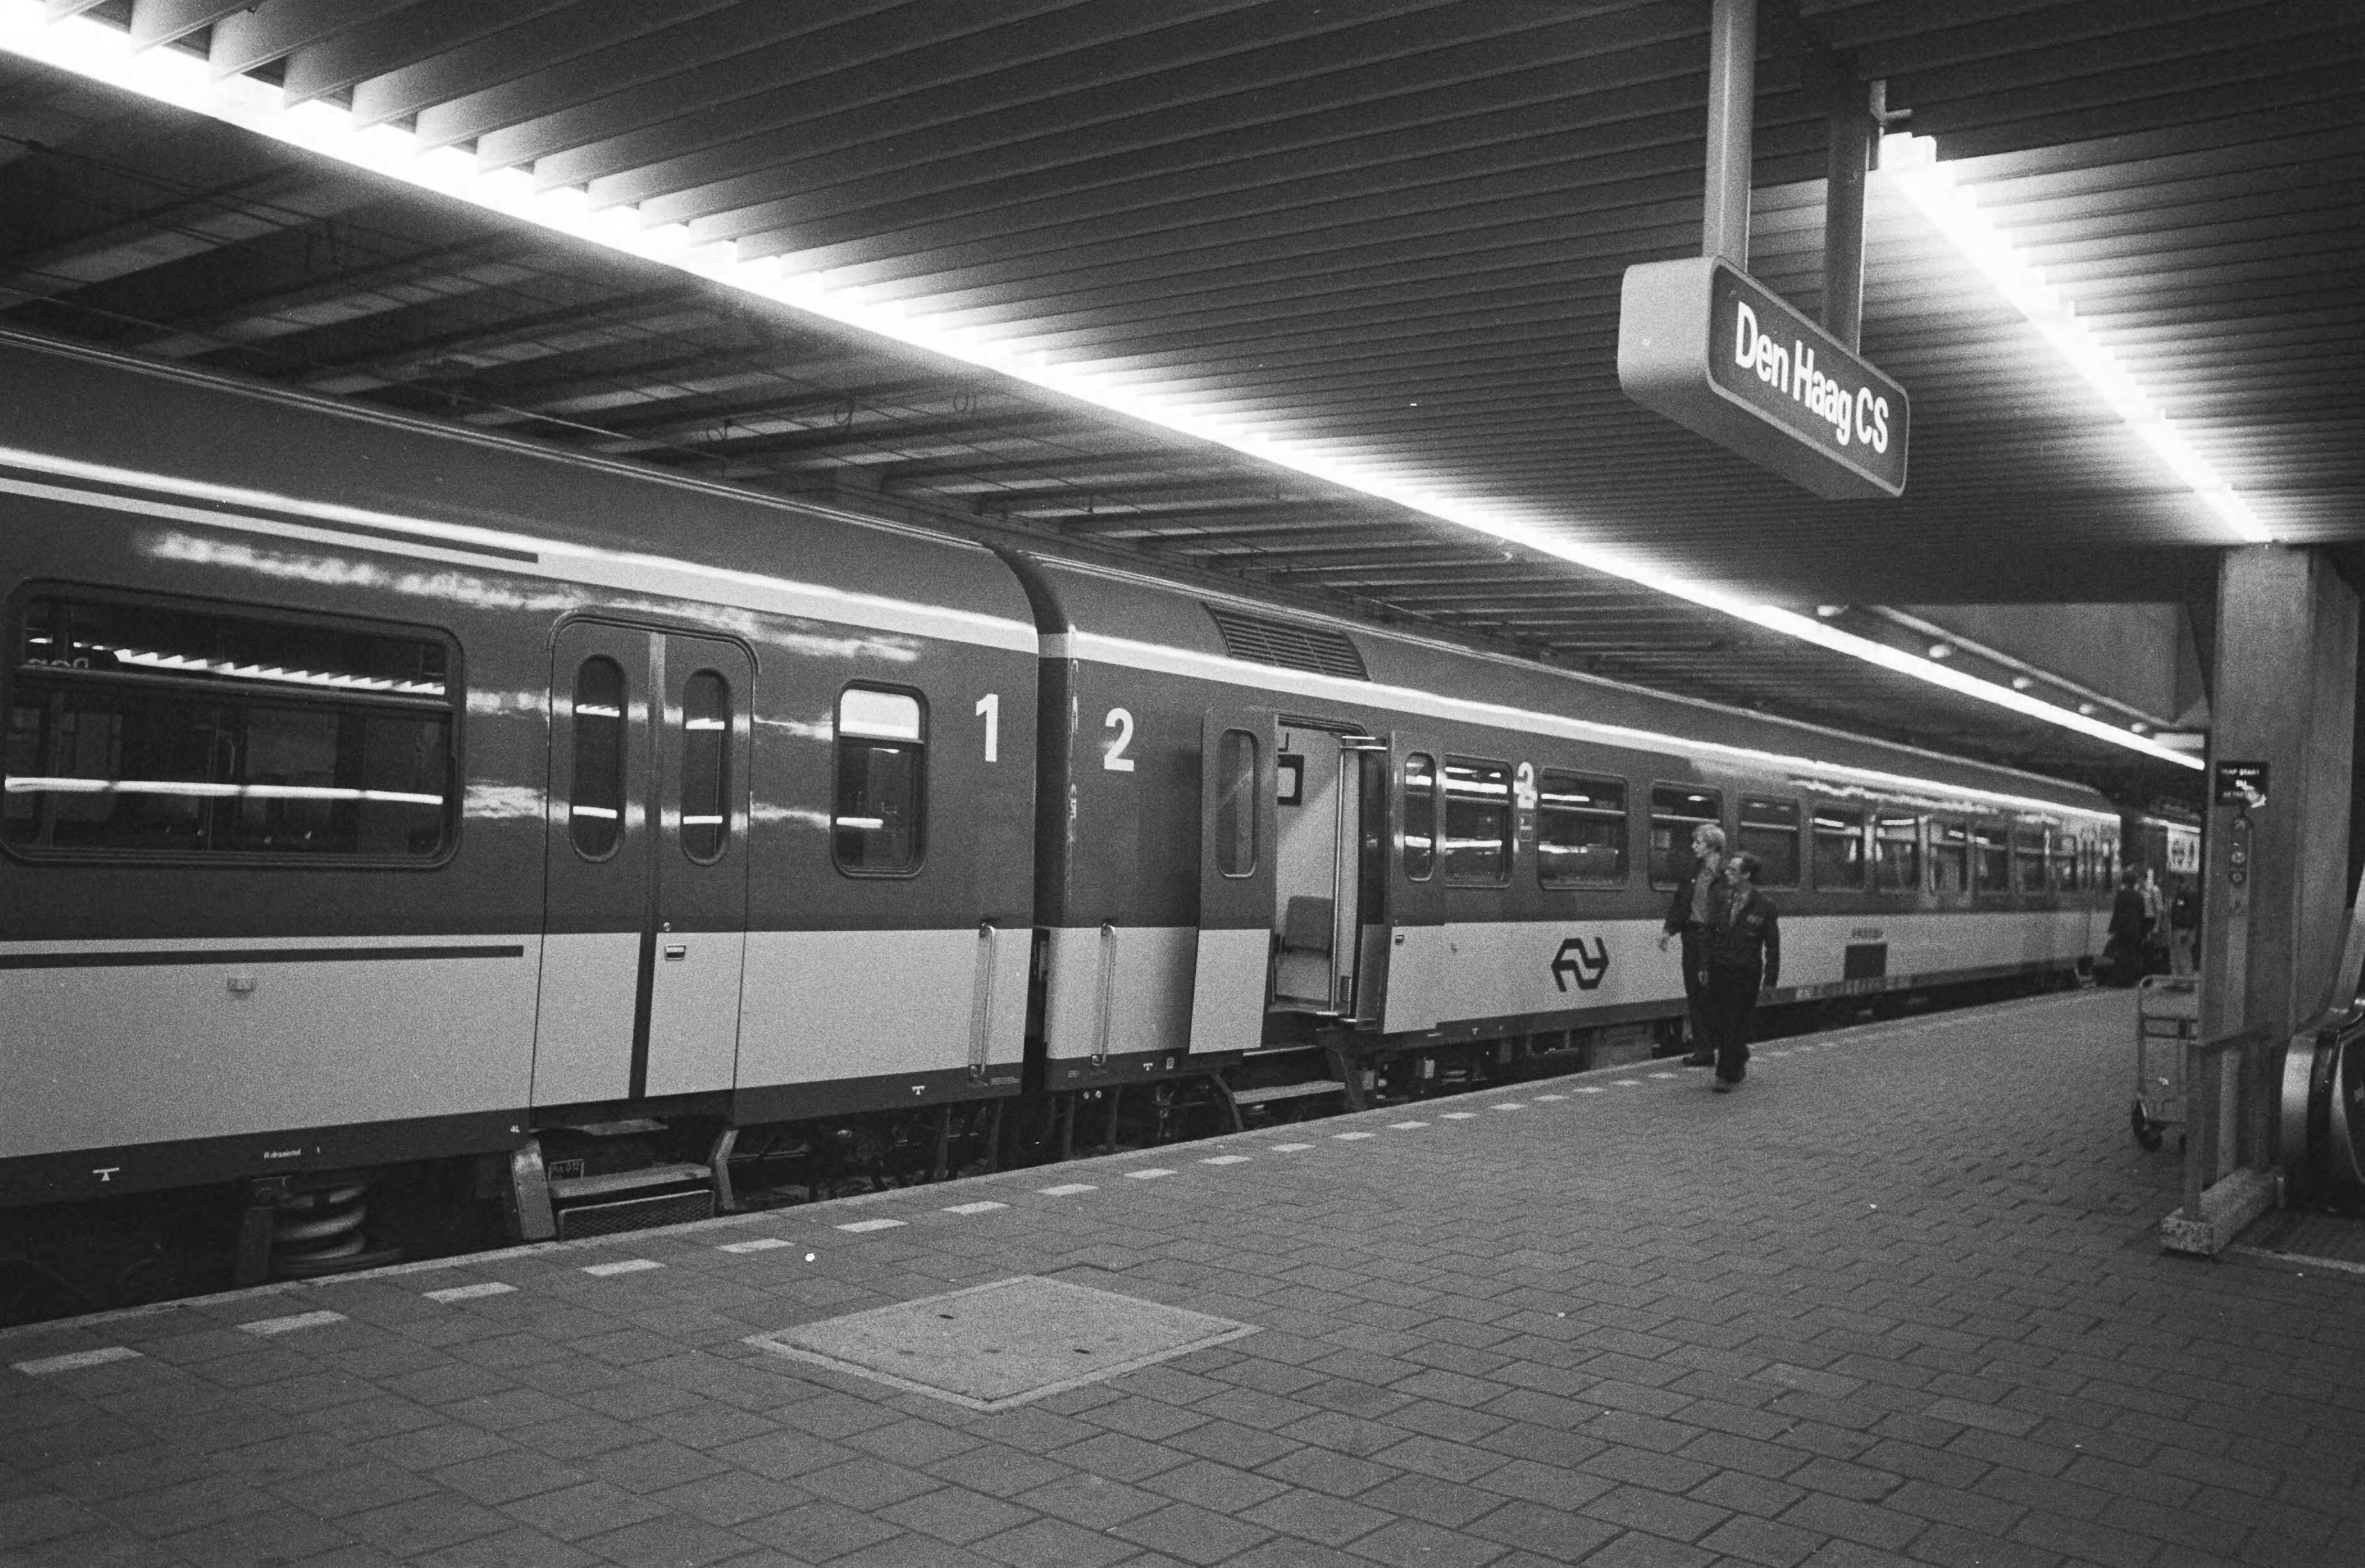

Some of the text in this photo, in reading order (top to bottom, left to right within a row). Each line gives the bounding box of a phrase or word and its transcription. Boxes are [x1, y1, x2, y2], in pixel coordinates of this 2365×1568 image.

[1735, 301, 1889, 453] Den Haag CS
[976, 693, 999, 762] 1
[1103, 707, 1134, 772] 2
[1518, 762, 1534, 809] 2
